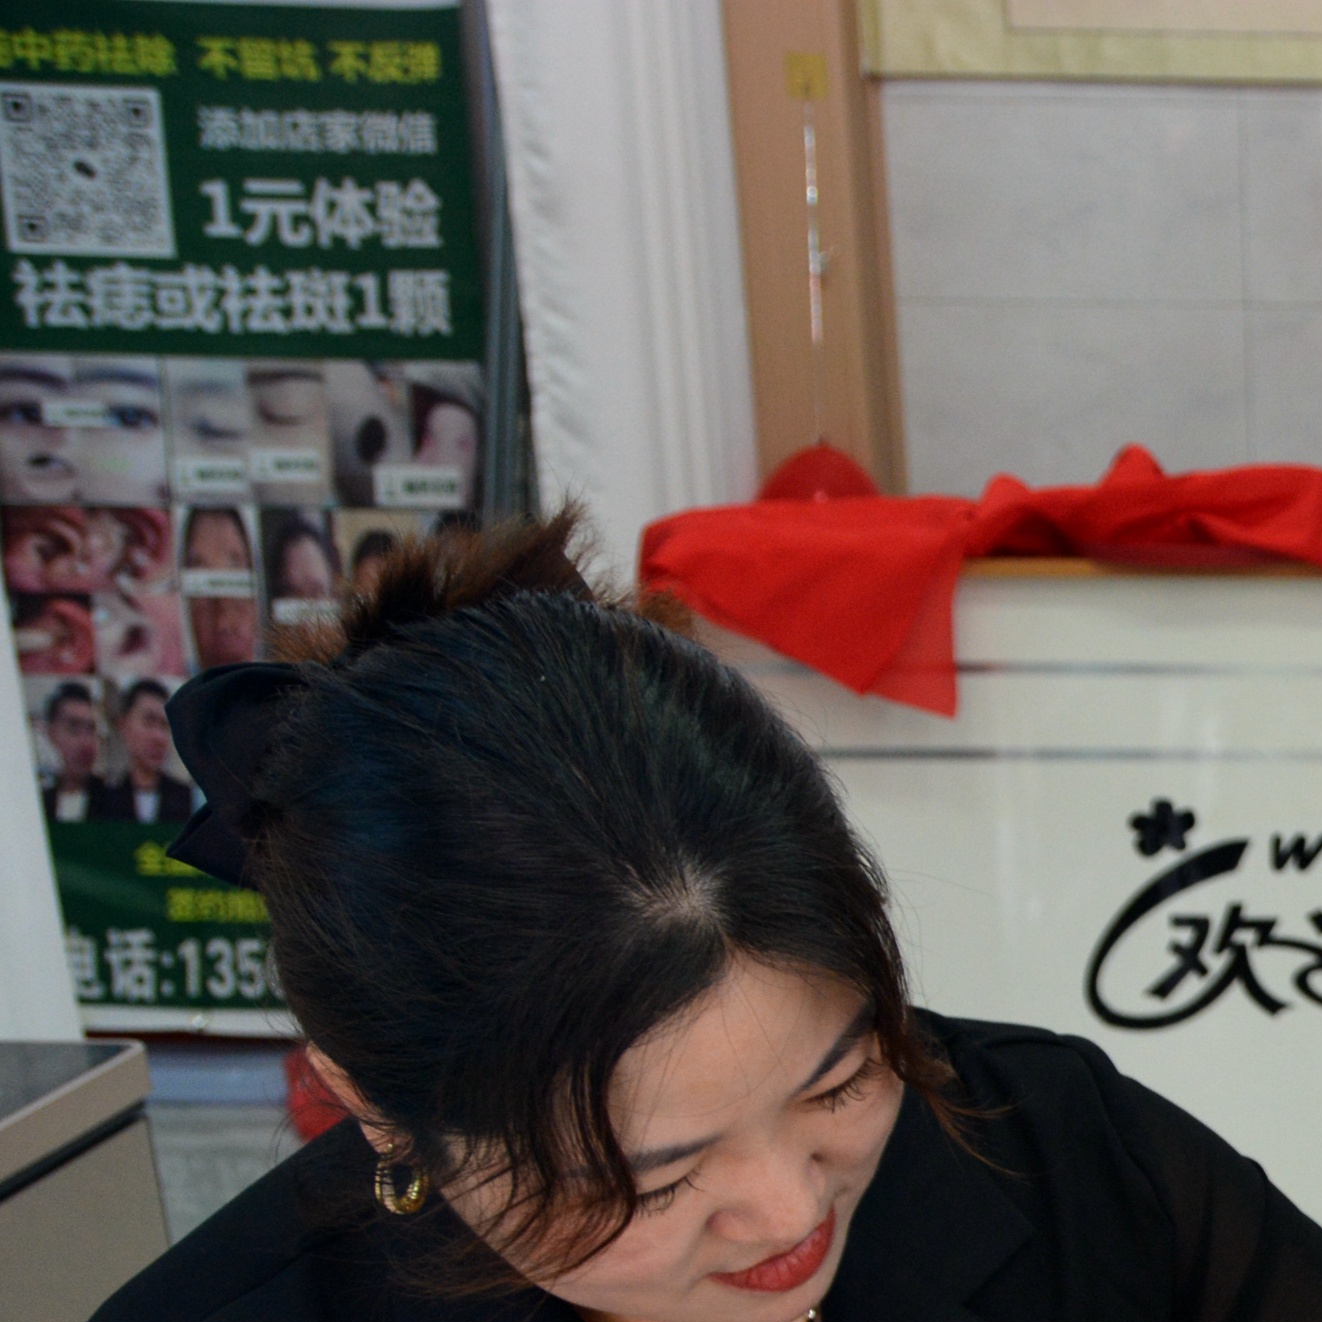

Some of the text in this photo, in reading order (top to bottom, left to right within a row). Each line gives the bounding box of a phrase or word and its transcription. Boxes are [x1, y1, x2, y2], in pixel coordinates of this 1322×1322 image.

[198, 106, 438, 155] 添加店家微信
[201, 178, 442, 250] 1元体验
[13, 260, 452, 336] 祛痣或祛斑1颗
